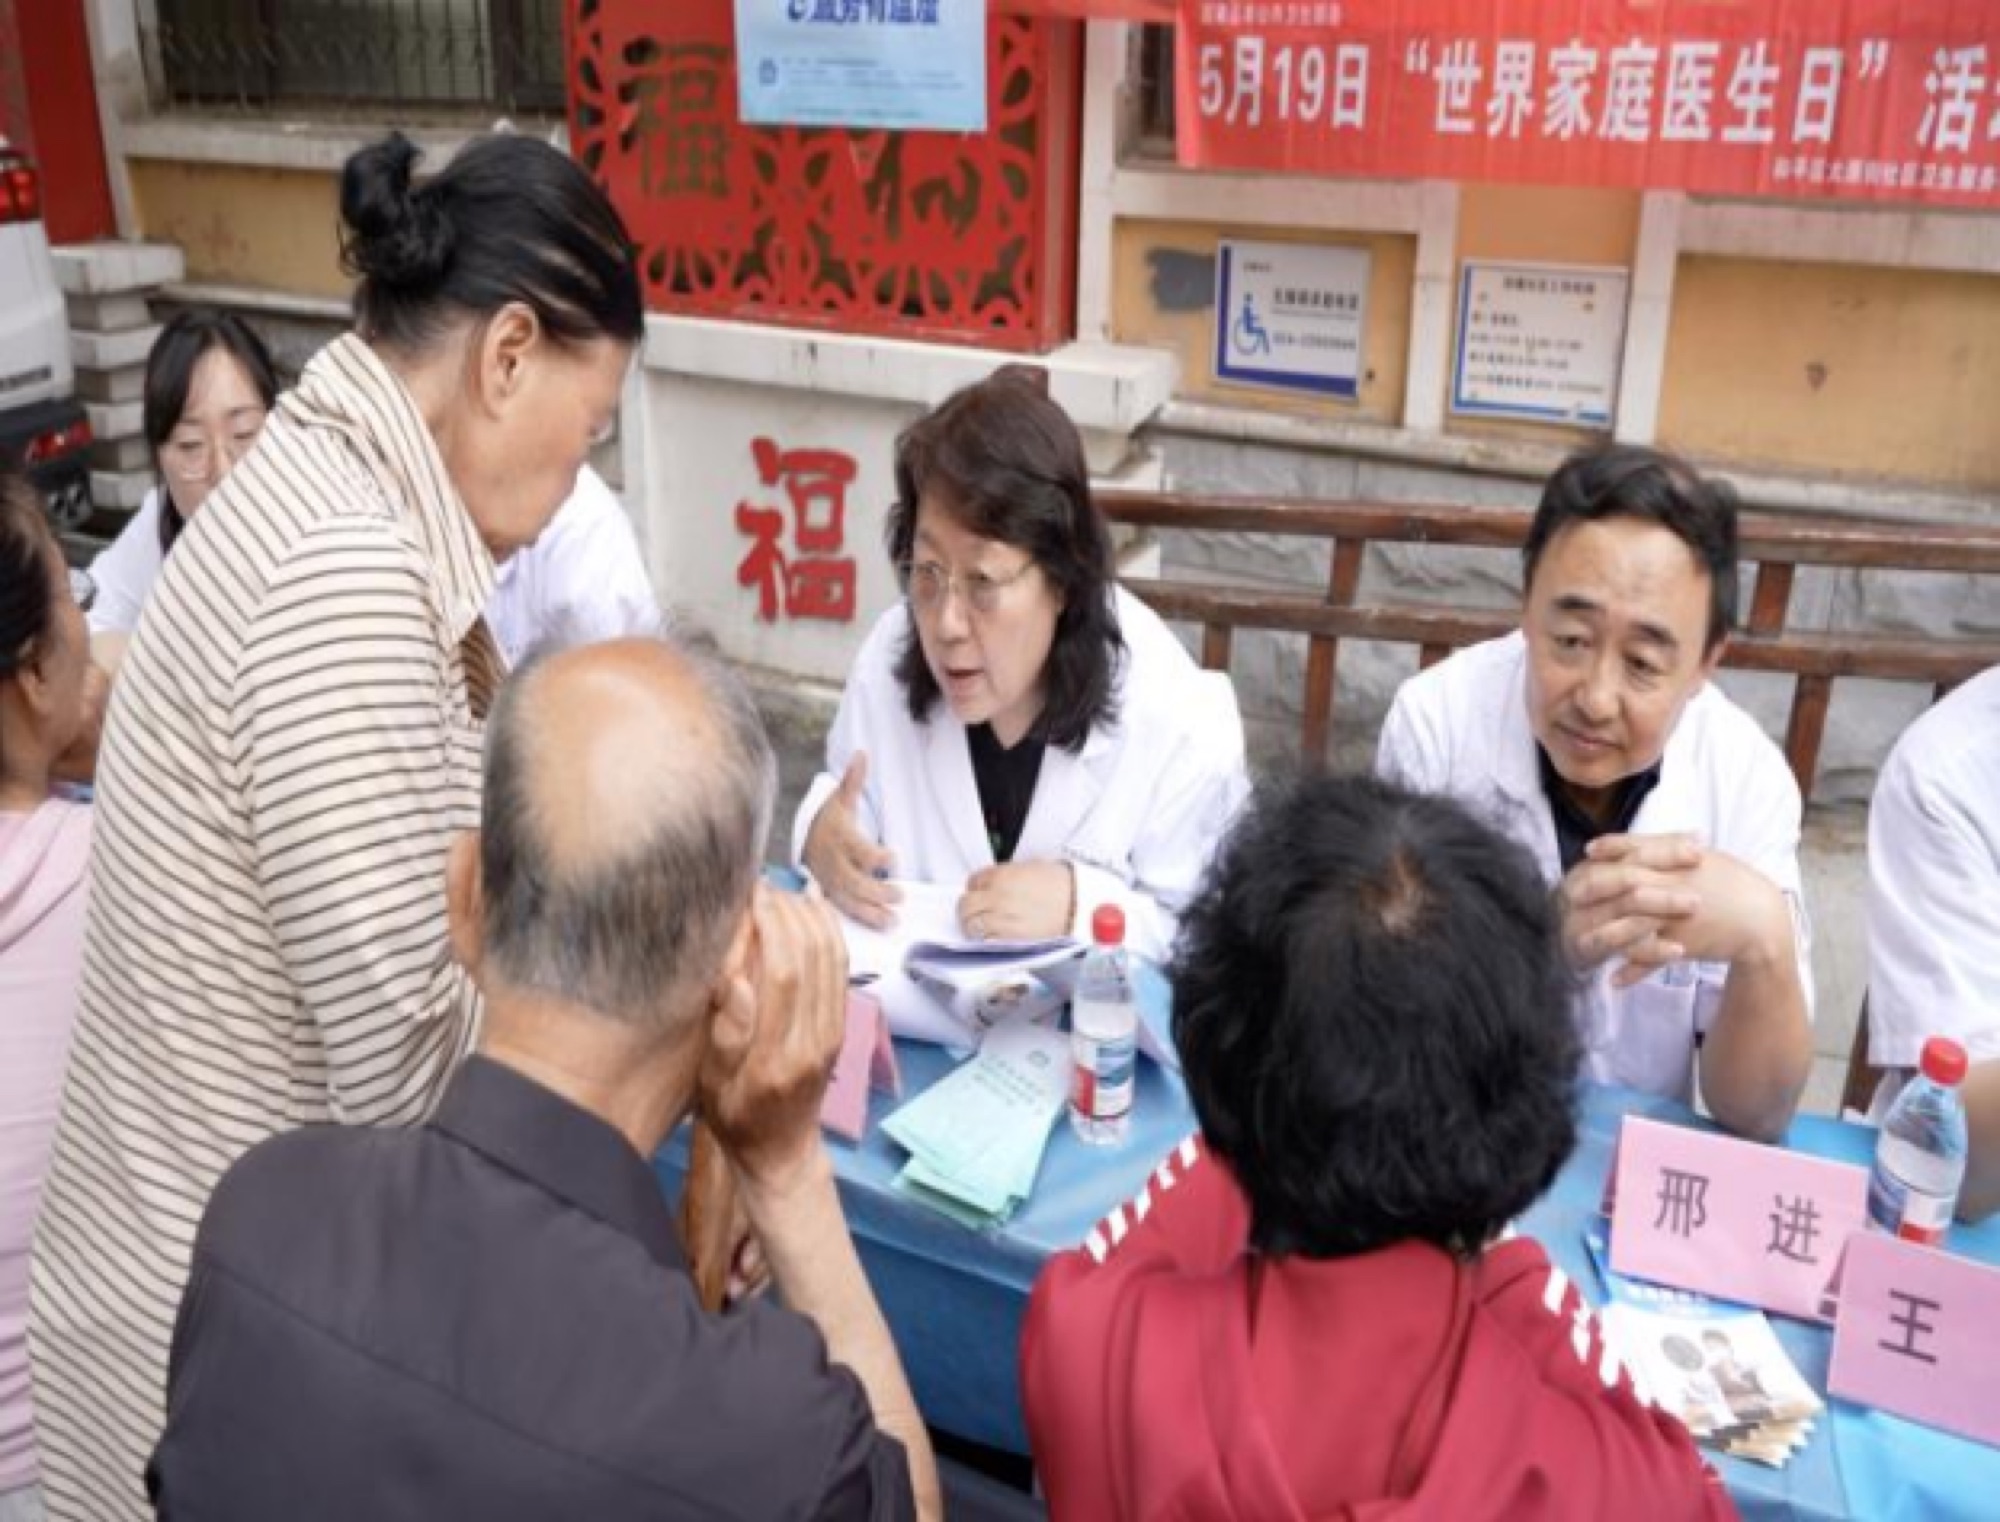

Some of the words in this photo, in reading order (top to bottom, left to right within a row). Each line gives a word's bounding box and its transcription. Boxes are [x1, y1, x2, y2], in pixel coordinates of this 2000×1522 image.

[1199, 36, 1370, 128] 5月19日
[1405, 39, 1889, 146] “世界家庭医生日”
[1915, 45, 2000, 153] 活
[735, 434, 858, 622] 福
[1654, 1166, 1710, 1238] 邢
[1766, 1193, 1822, 1264] 进
[1877, 1287, 1942, 1365] 王
